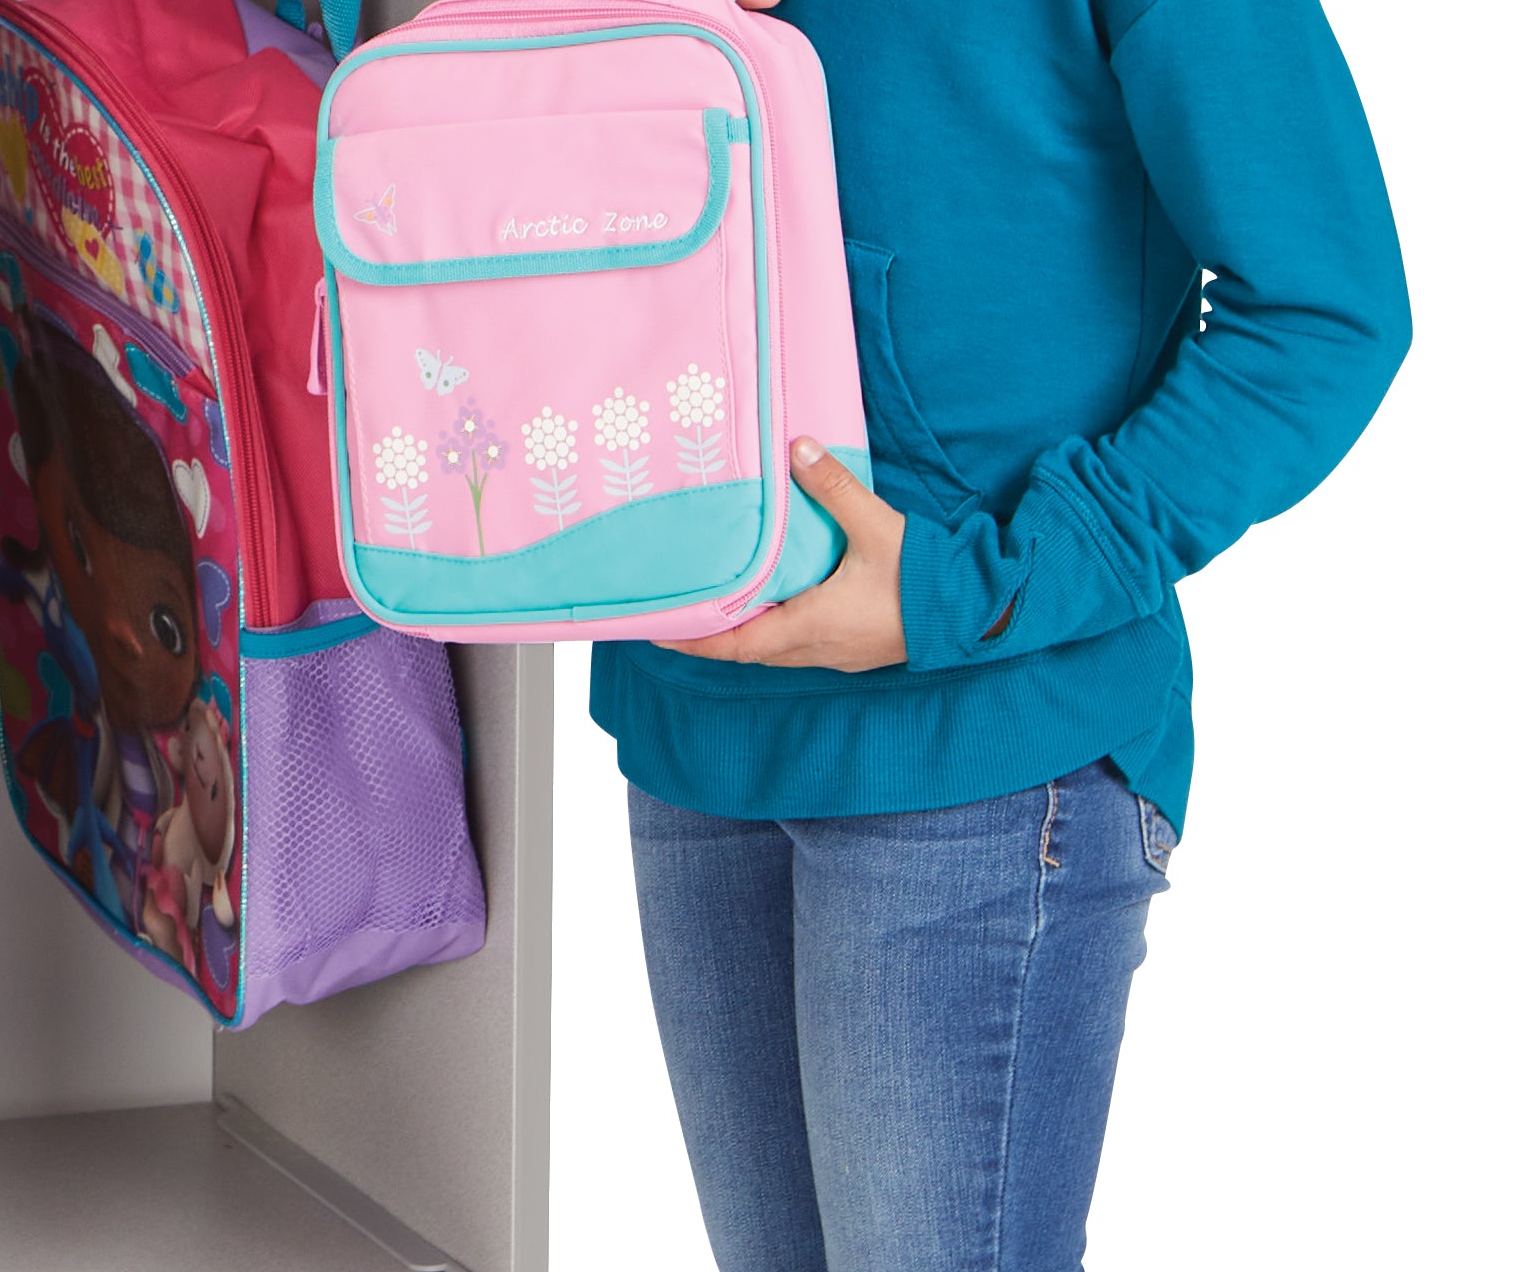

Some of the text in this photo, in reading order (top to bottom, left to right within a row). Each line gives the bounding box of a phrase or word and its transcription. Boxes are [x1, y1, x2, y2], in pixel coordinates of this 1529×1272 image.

[53, 138, 77, 178] the
[74, 155, 108, 190] best
[501, 211, 669, 241] Arctic Zone
